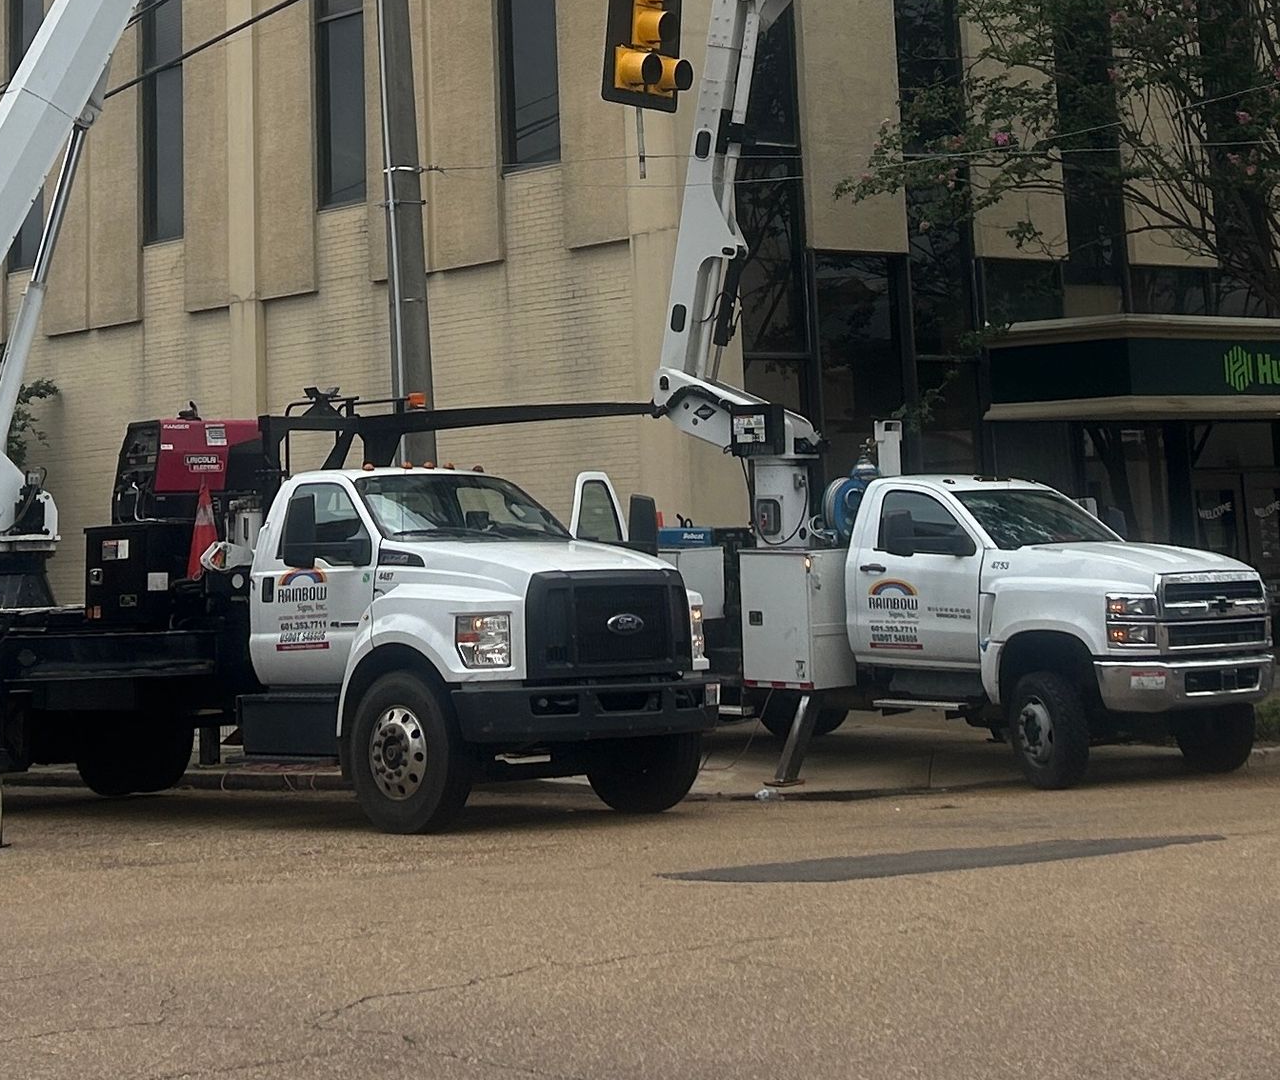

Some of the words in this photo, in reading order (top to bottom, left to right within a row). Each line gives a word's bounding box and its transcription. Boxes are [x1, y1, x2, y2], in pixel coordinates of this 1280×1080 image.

[186, 456, 217, 464] LINCOLN
[1198, 502, 1232, 520] WELCOME
[277, 586, 327, 603] RAINBOW
[868, 597, 918, 610] RAINBOW
